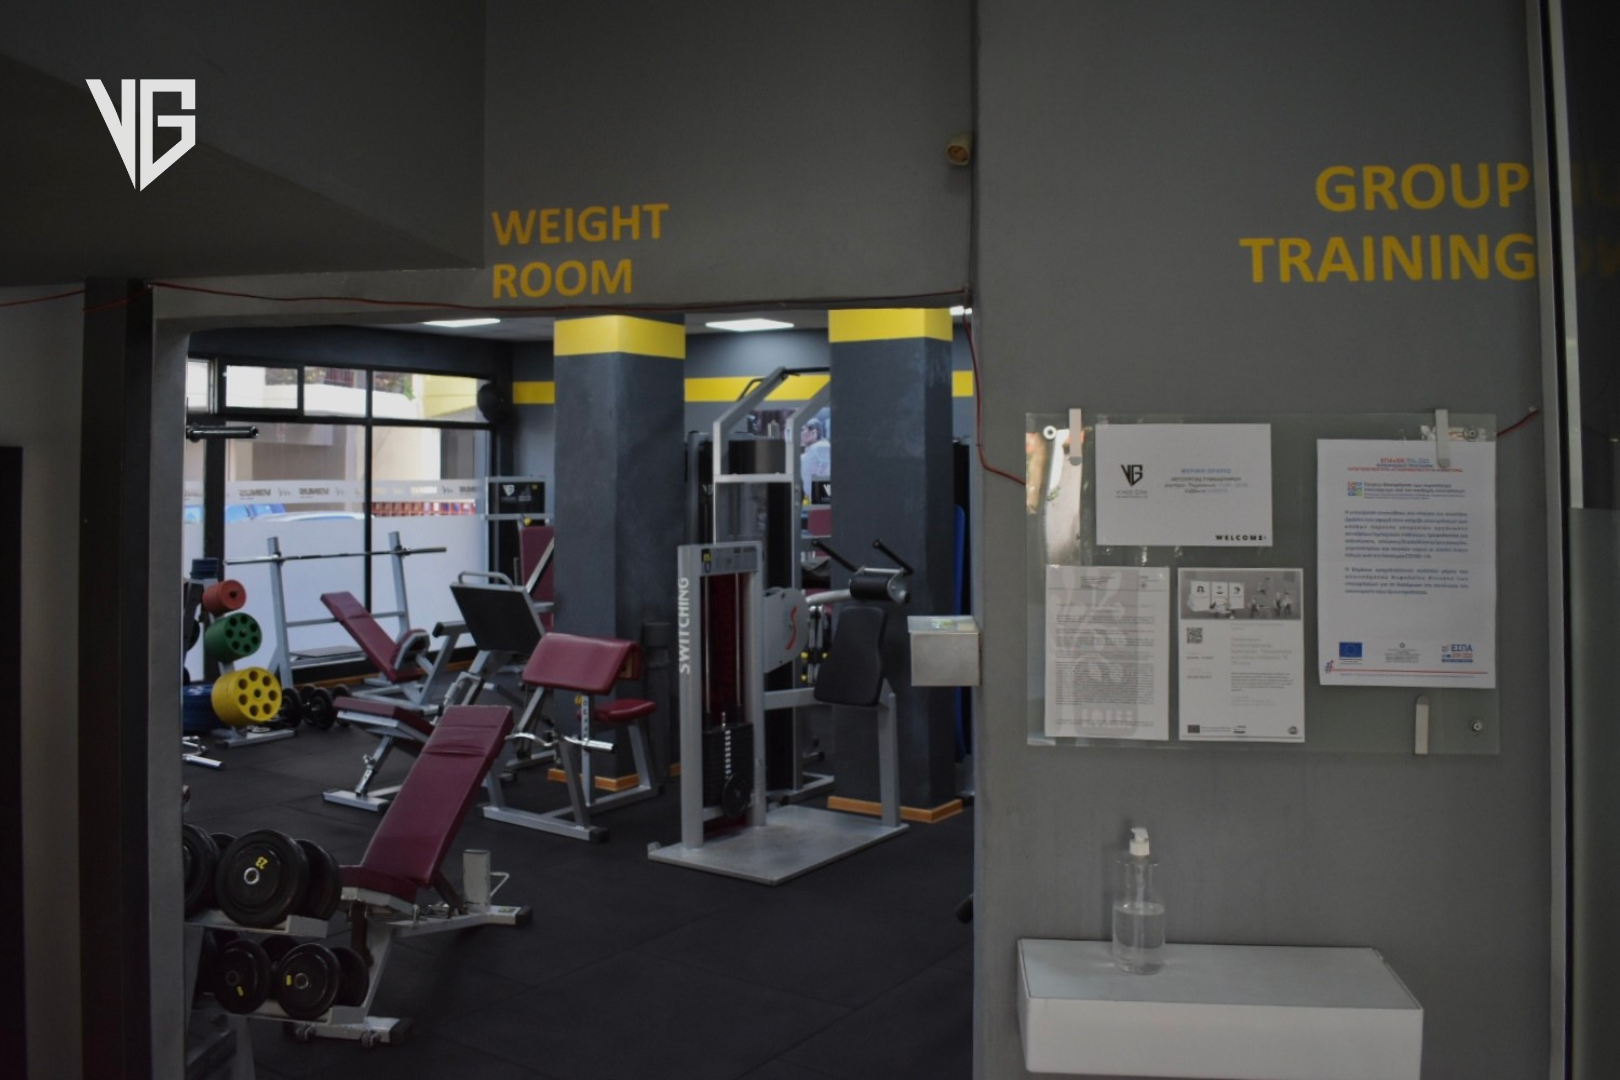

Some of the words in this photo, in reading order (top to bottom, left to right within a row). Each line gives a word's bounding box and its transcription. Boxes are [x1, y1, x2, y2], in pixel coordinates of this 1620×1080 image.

[1315, 163, 1530, 212] GROUP
[491, 203, 670, 246] WEIGHT
[492, 258, 633, 299] ROOM
[1239, 233, 1536, 283] TRAINING
[678, 577, 691, 674] SWITCHING
[1451, 644, 1473, 652] ΕΣΠΑ
